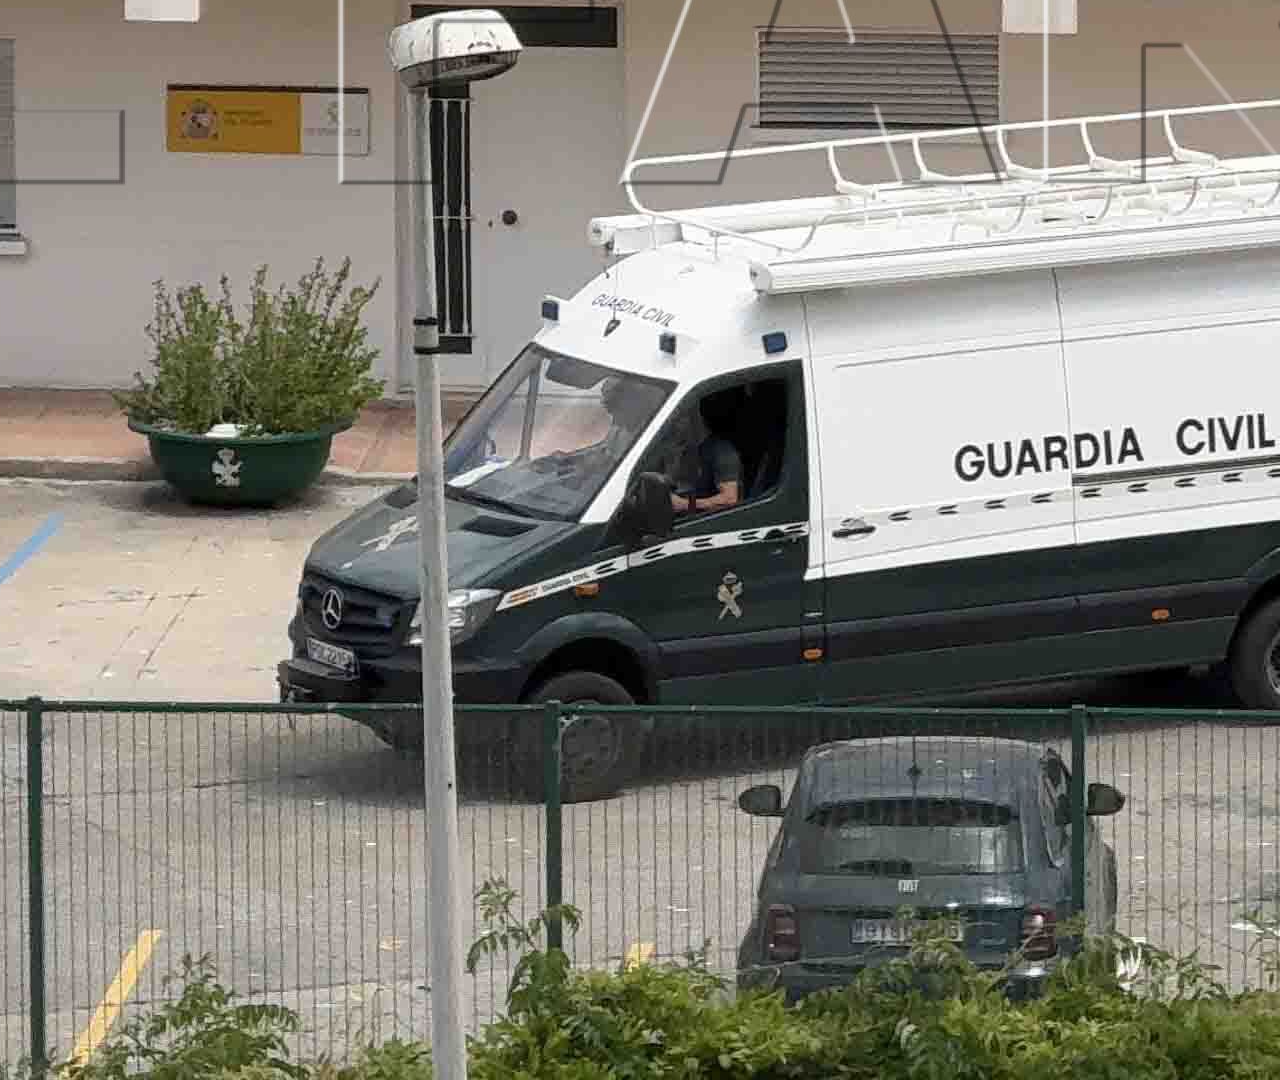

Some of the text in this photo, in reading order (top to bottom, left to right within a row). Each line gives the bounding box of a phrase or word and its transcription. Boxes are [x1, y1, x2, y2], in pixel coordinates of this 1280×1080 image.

[592, 293, 676, 328] GUARDIA CIVIL
[953, 412, 1276, 482] GUARDIA CIVIL
